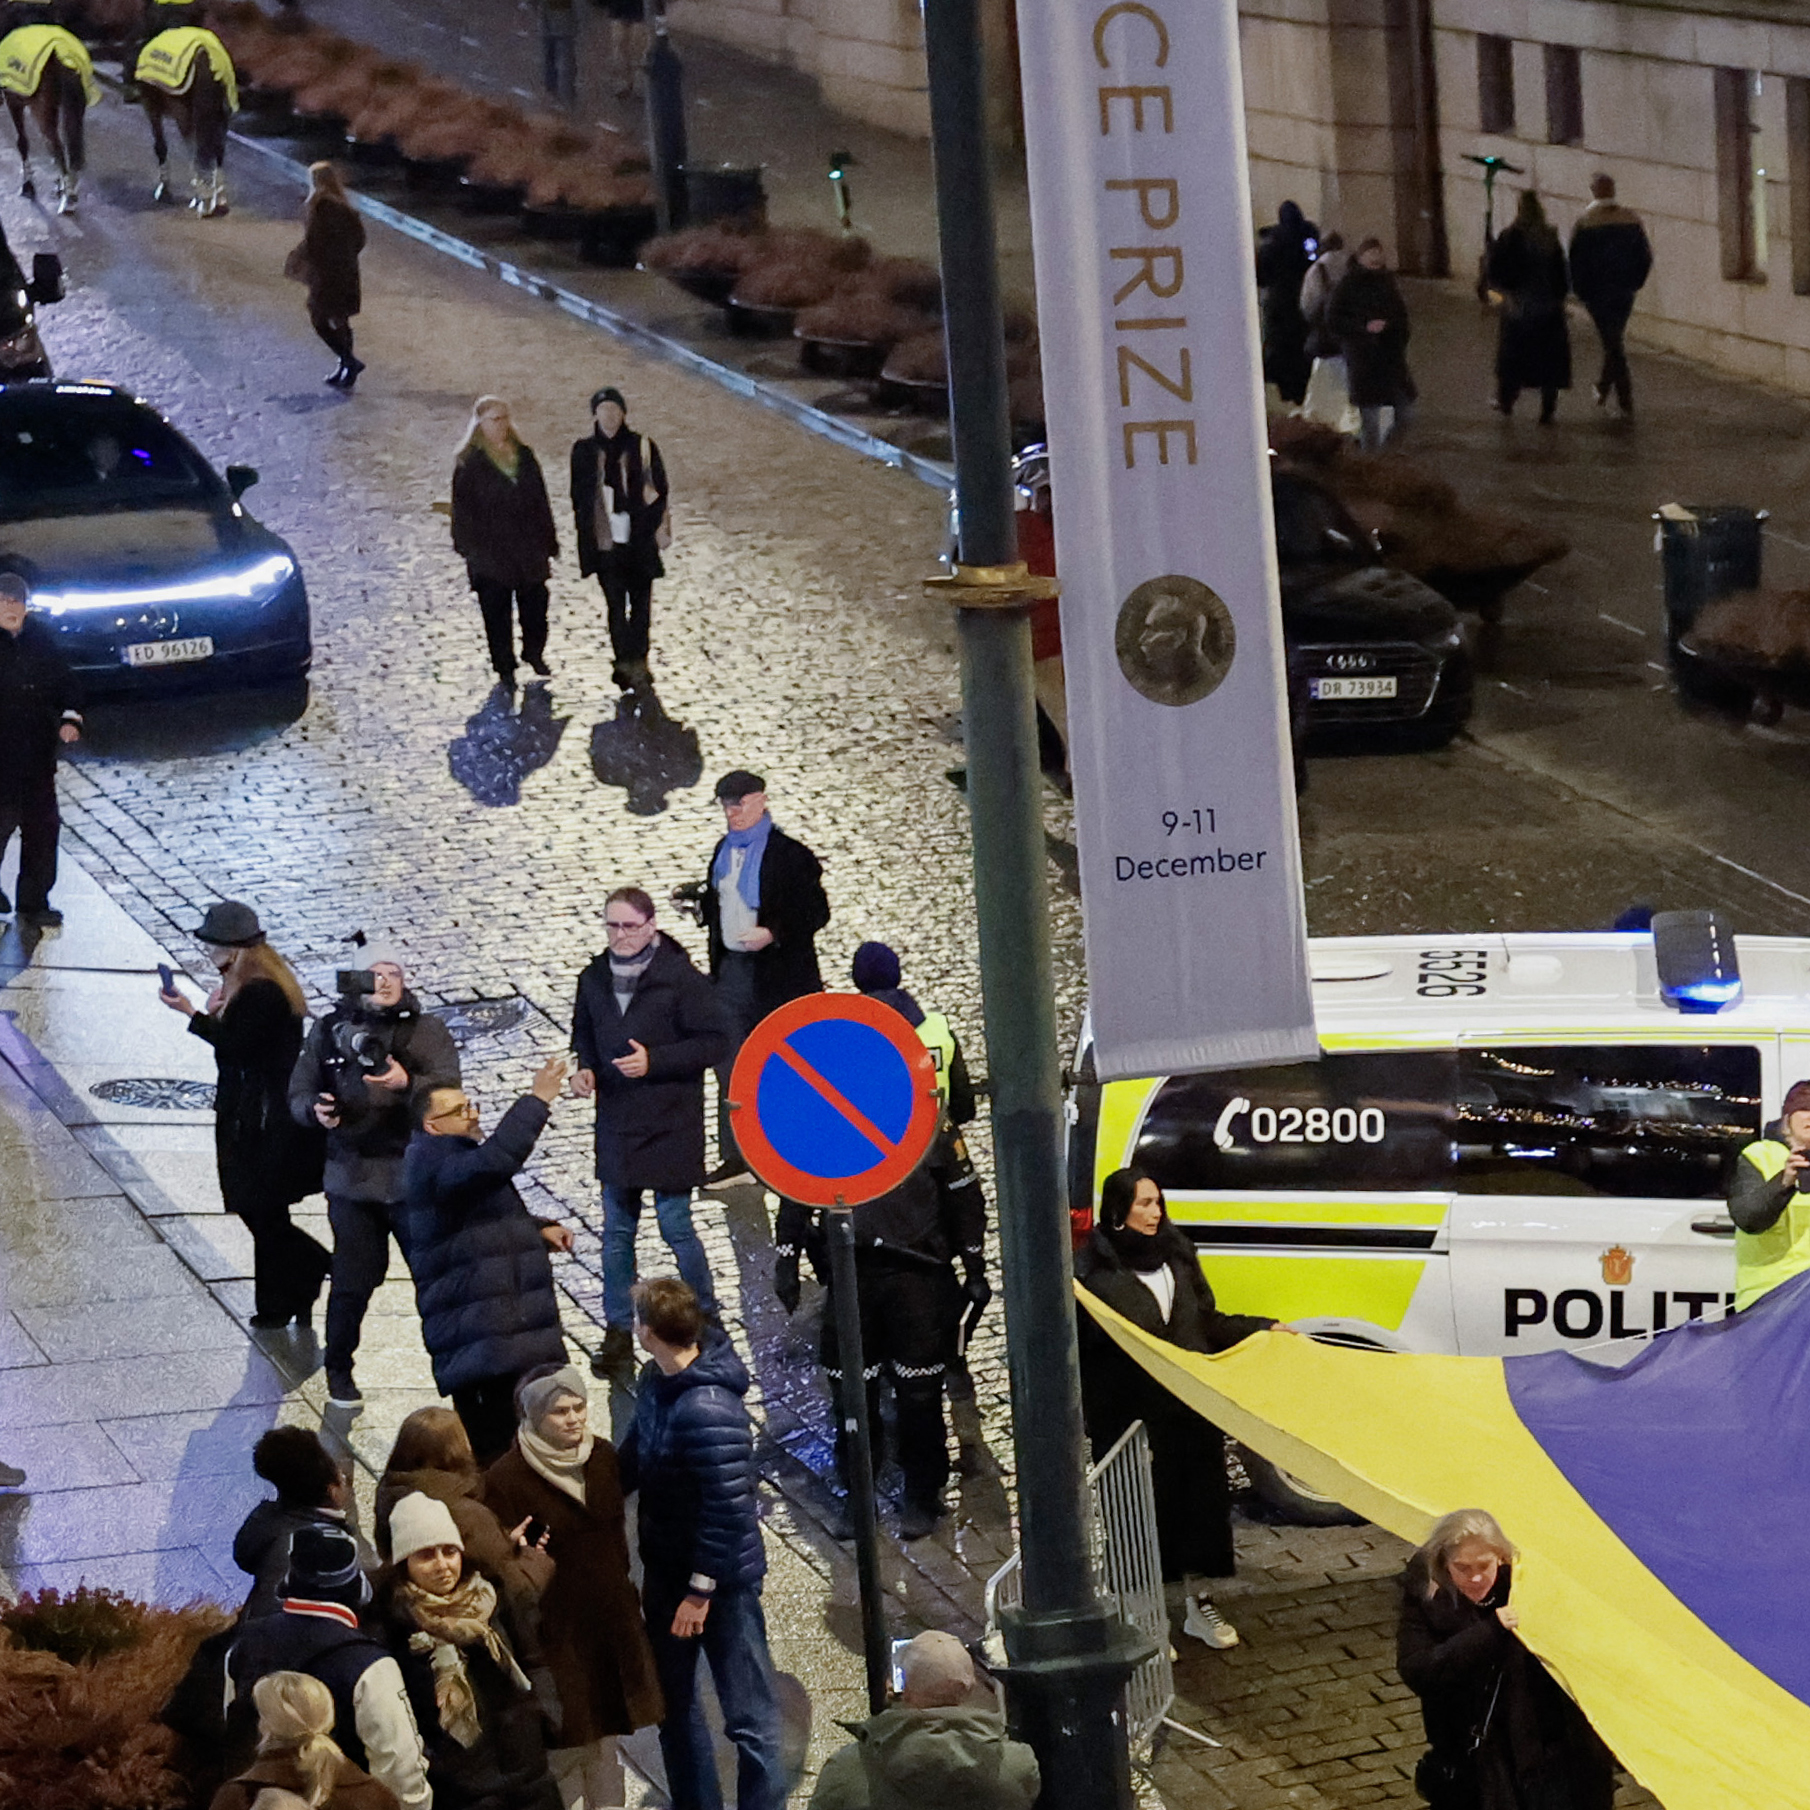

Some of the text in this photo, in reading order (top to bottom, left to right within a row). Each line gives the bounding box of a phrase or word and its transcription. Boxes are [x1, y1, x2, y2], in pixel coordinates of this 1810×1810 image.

[1092, 1, 1198, 469] CE PRIZE
[1162, 809, 1215, 836] 9-11
[1116, 848, 1267, 881] December
[1417, 950, 1487, 997] 5526
[1252, 1107, 1385, 1143] 02800
